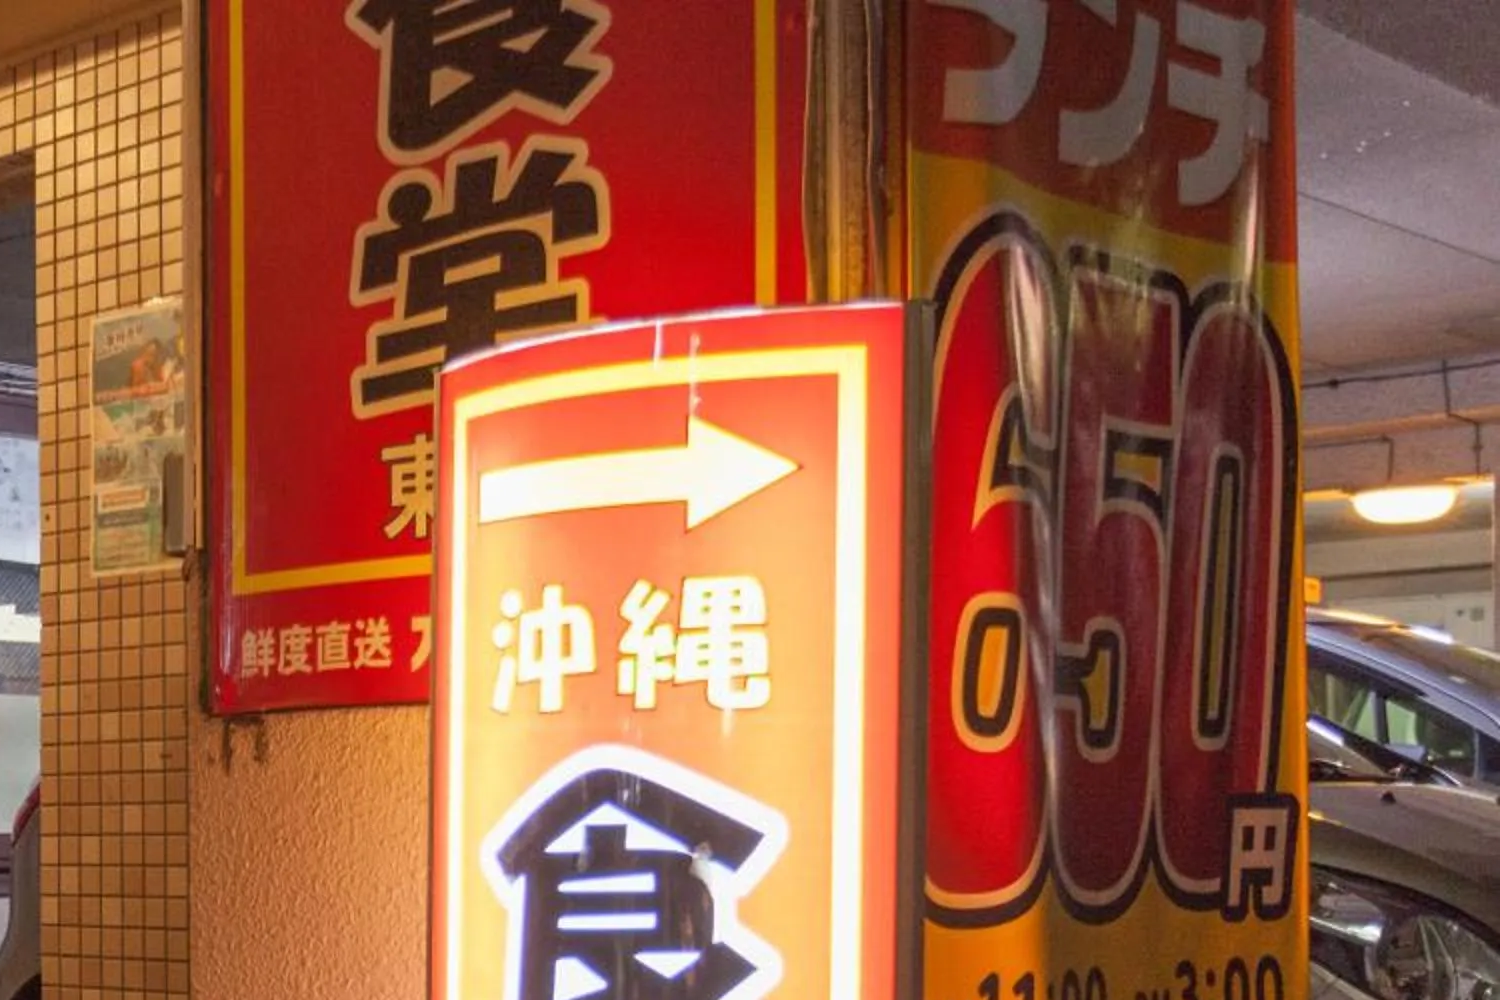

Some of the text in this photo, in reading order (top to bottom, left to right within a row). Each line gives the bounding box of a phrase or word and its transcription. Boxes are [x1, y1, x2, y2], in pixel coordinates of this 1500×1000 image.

[241, 615, 392, 678] 鮮度直送
[490, 575, 772, 714] 沖縄
